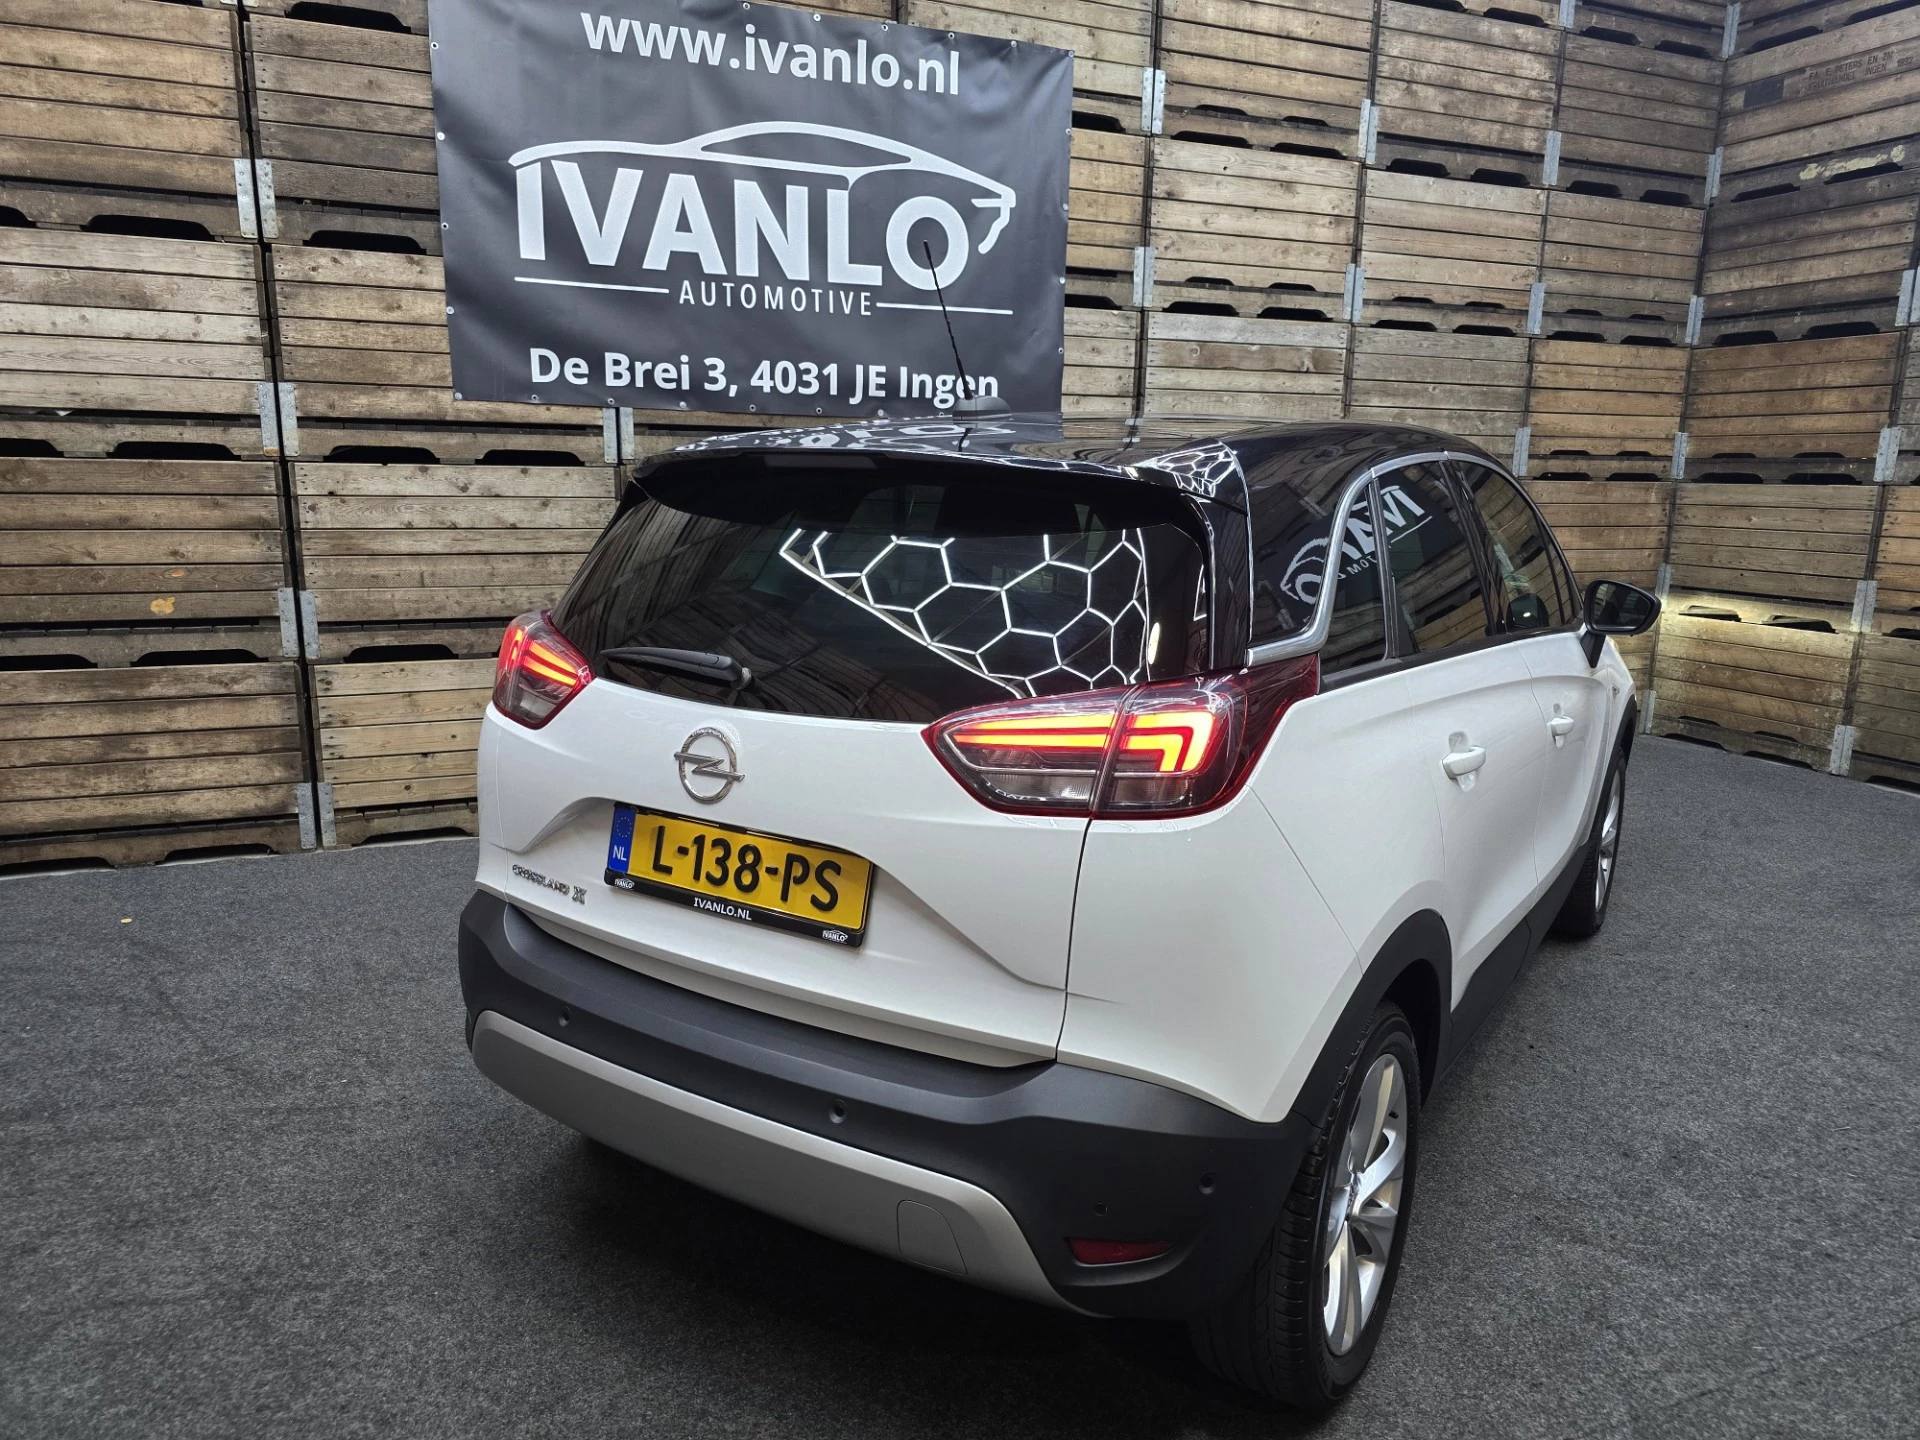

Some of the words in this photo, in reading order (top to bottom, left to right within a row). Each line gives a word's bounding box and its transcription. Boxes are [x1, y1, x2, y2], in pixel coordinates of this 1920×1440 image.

[580, 11, 960, 96] www.ivanlo.nl
[1867, 54, 1879, 65] EN
[515, 159, 969, 291] IVANLO
[679, 280, 873, 317] AUTOMOTIVE
[529, 347, 590, 386] De
[604, 352, 691, 391] Brei
[703, 357, 739, 398] 3,
[750, 360, 840, 397] 4031
[849, 364, 888, 404] JE
[899, 366, 999, 409] Ingen
[612, 844, 628, 862] NL
[652, 824, 843, 913] L-138-PS
[571, 885, 588, 905] X
[614, 878, 634, 889] IVANLO
[693, 897, 752, 921] IVANLO.NL
[822, 930, 846, 942] IVANLO
